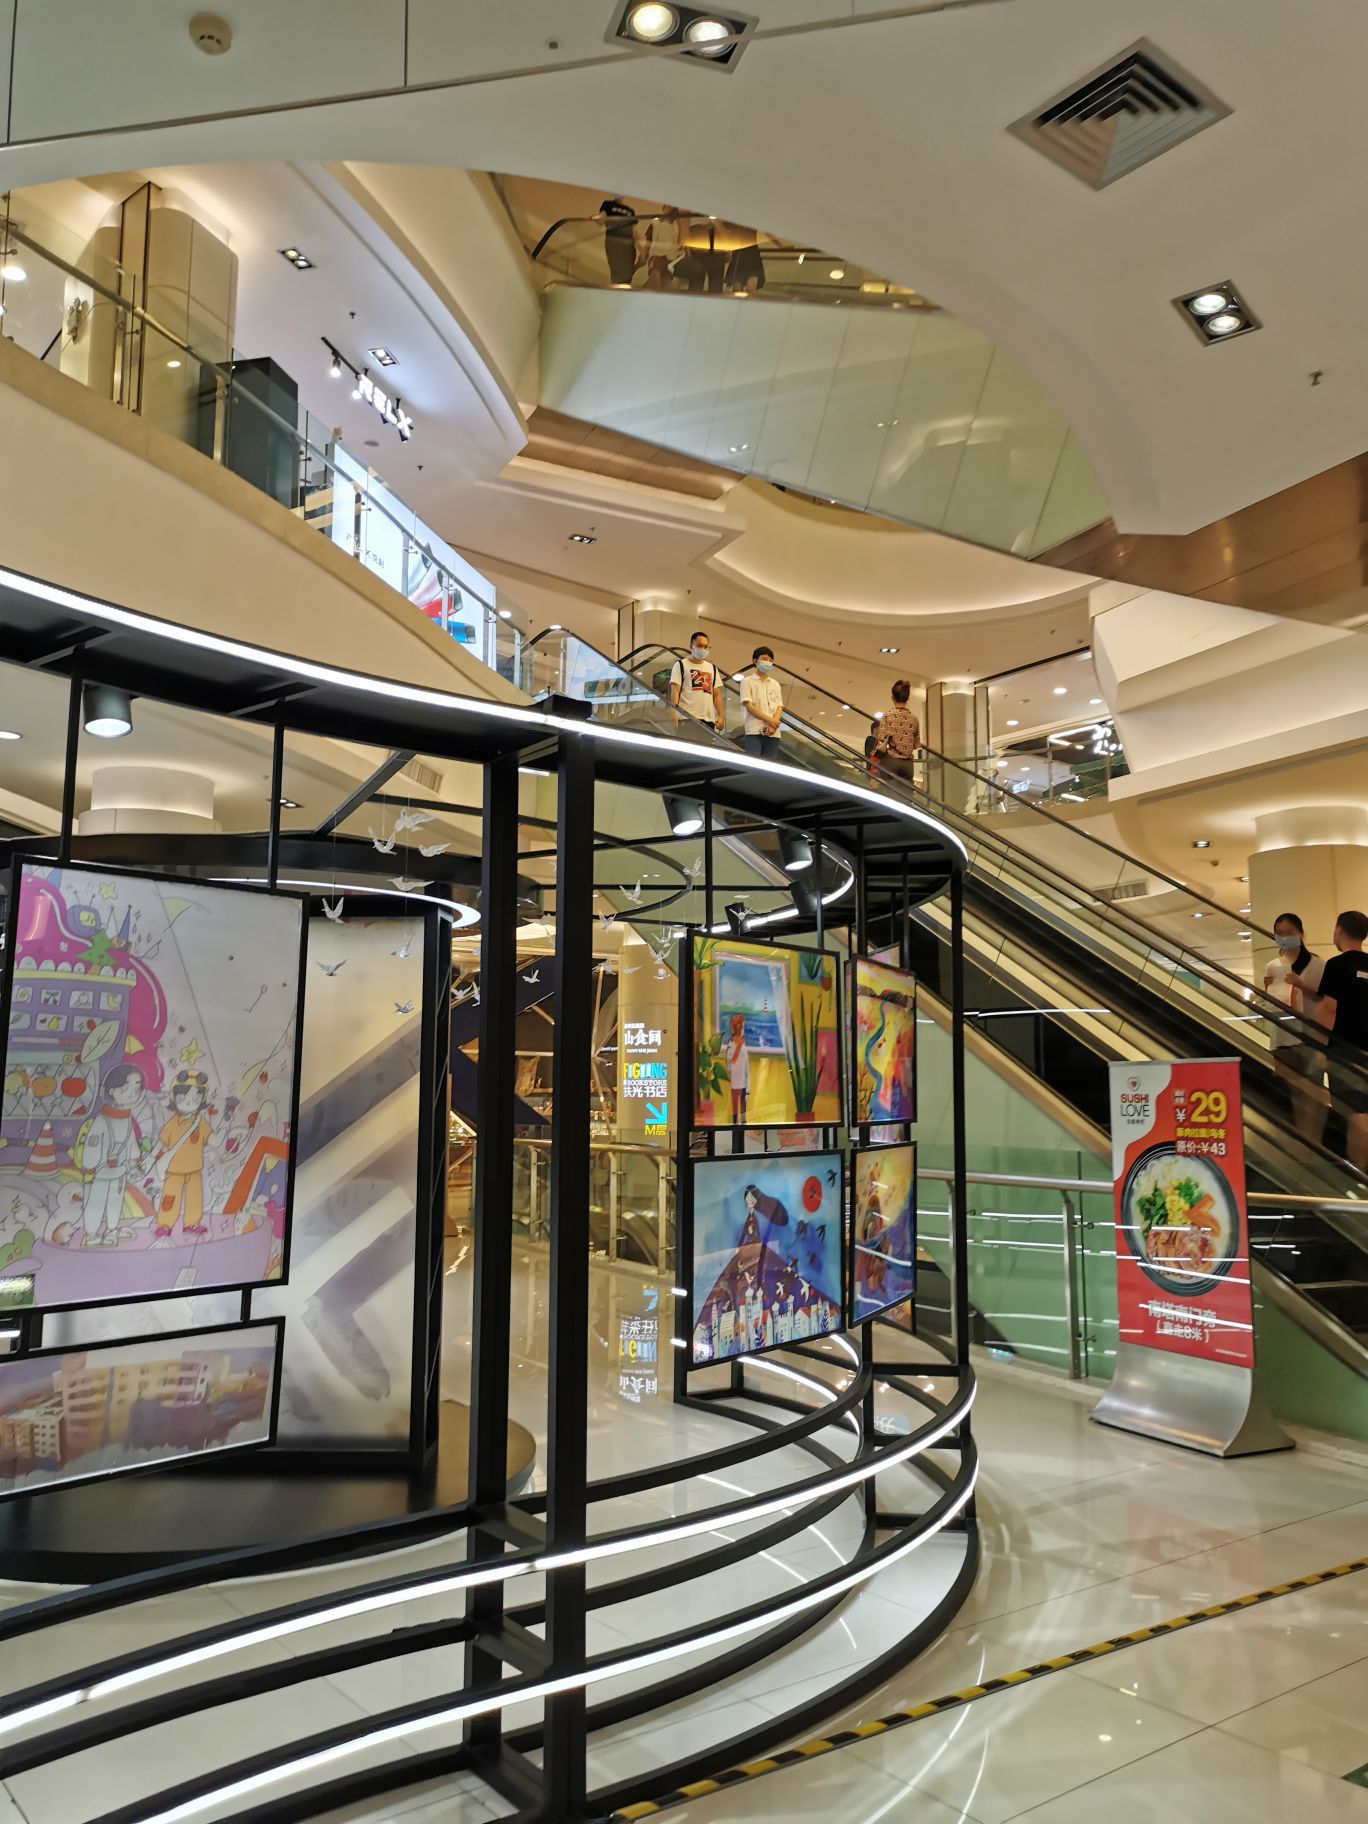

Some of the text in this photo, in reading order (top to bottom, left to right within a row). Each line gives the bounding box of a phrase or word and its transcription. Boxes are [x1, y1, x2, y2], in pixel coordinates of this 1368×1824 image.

[359, 373, 413, 438] RELX
[1120, 1093, 1149, 1104] SUSHI
[1120, 1103, 1150, 1117] LOVE
[1190, 1091, 1227, 1124] 29
